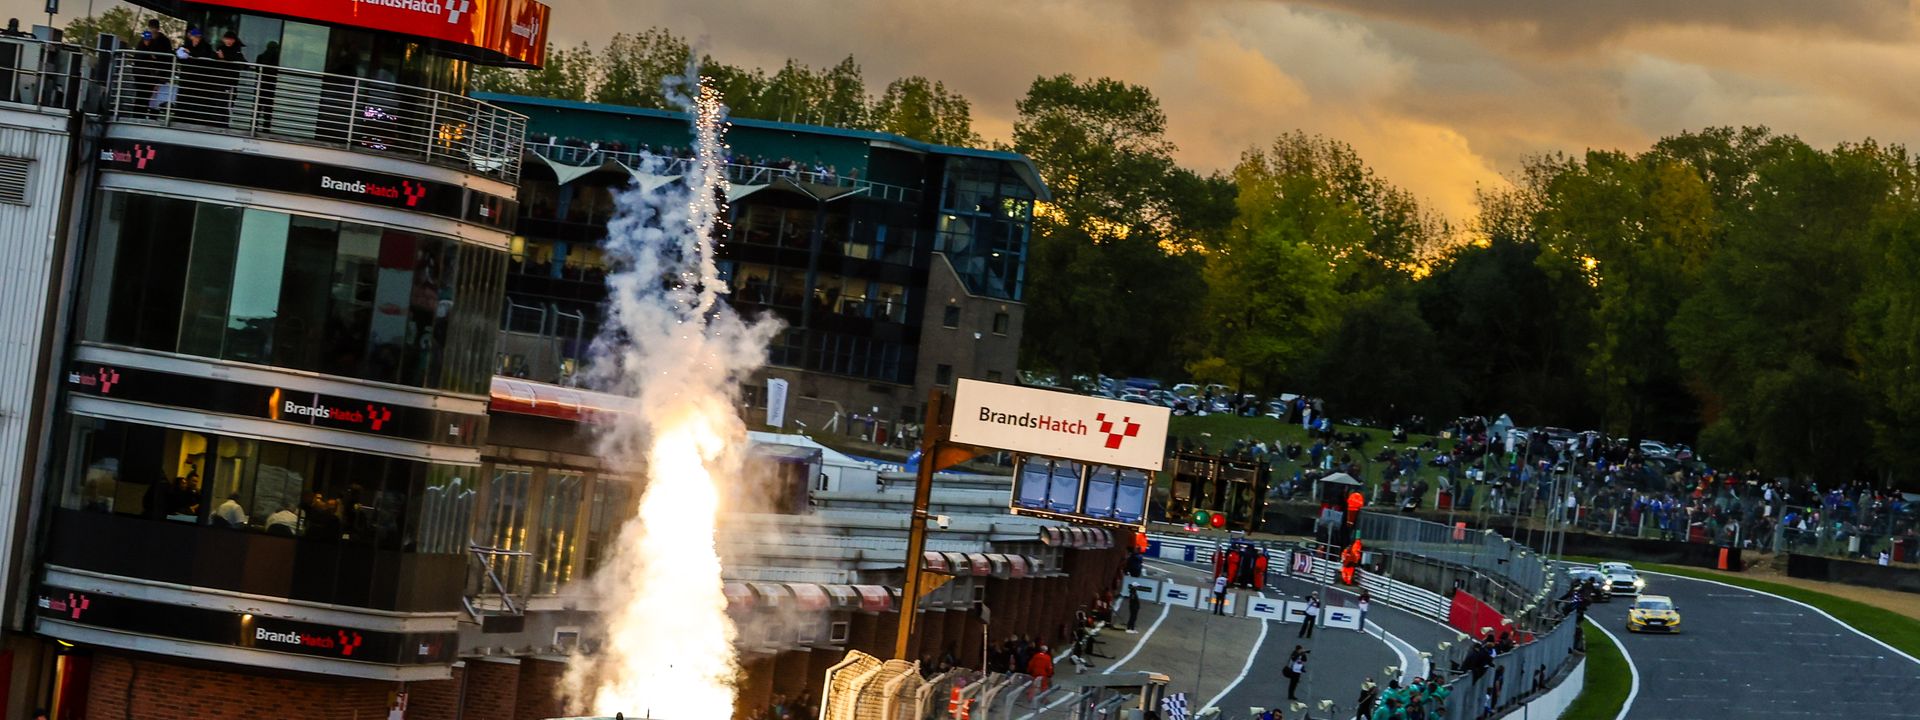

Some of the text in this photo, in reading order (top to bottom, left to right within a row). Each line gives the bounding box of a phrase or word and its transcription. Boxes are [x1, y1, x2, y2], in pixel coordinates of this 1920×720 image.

[351, 0, 441, 14] nsHatch
[321, 176, 399, 199] BrandsHatch
[284, 400, 364, 423] BrandsHatch
[979, 406, 1087, 435] BrandsHatch
[255, 627, 334, 649] BrandsHatch
